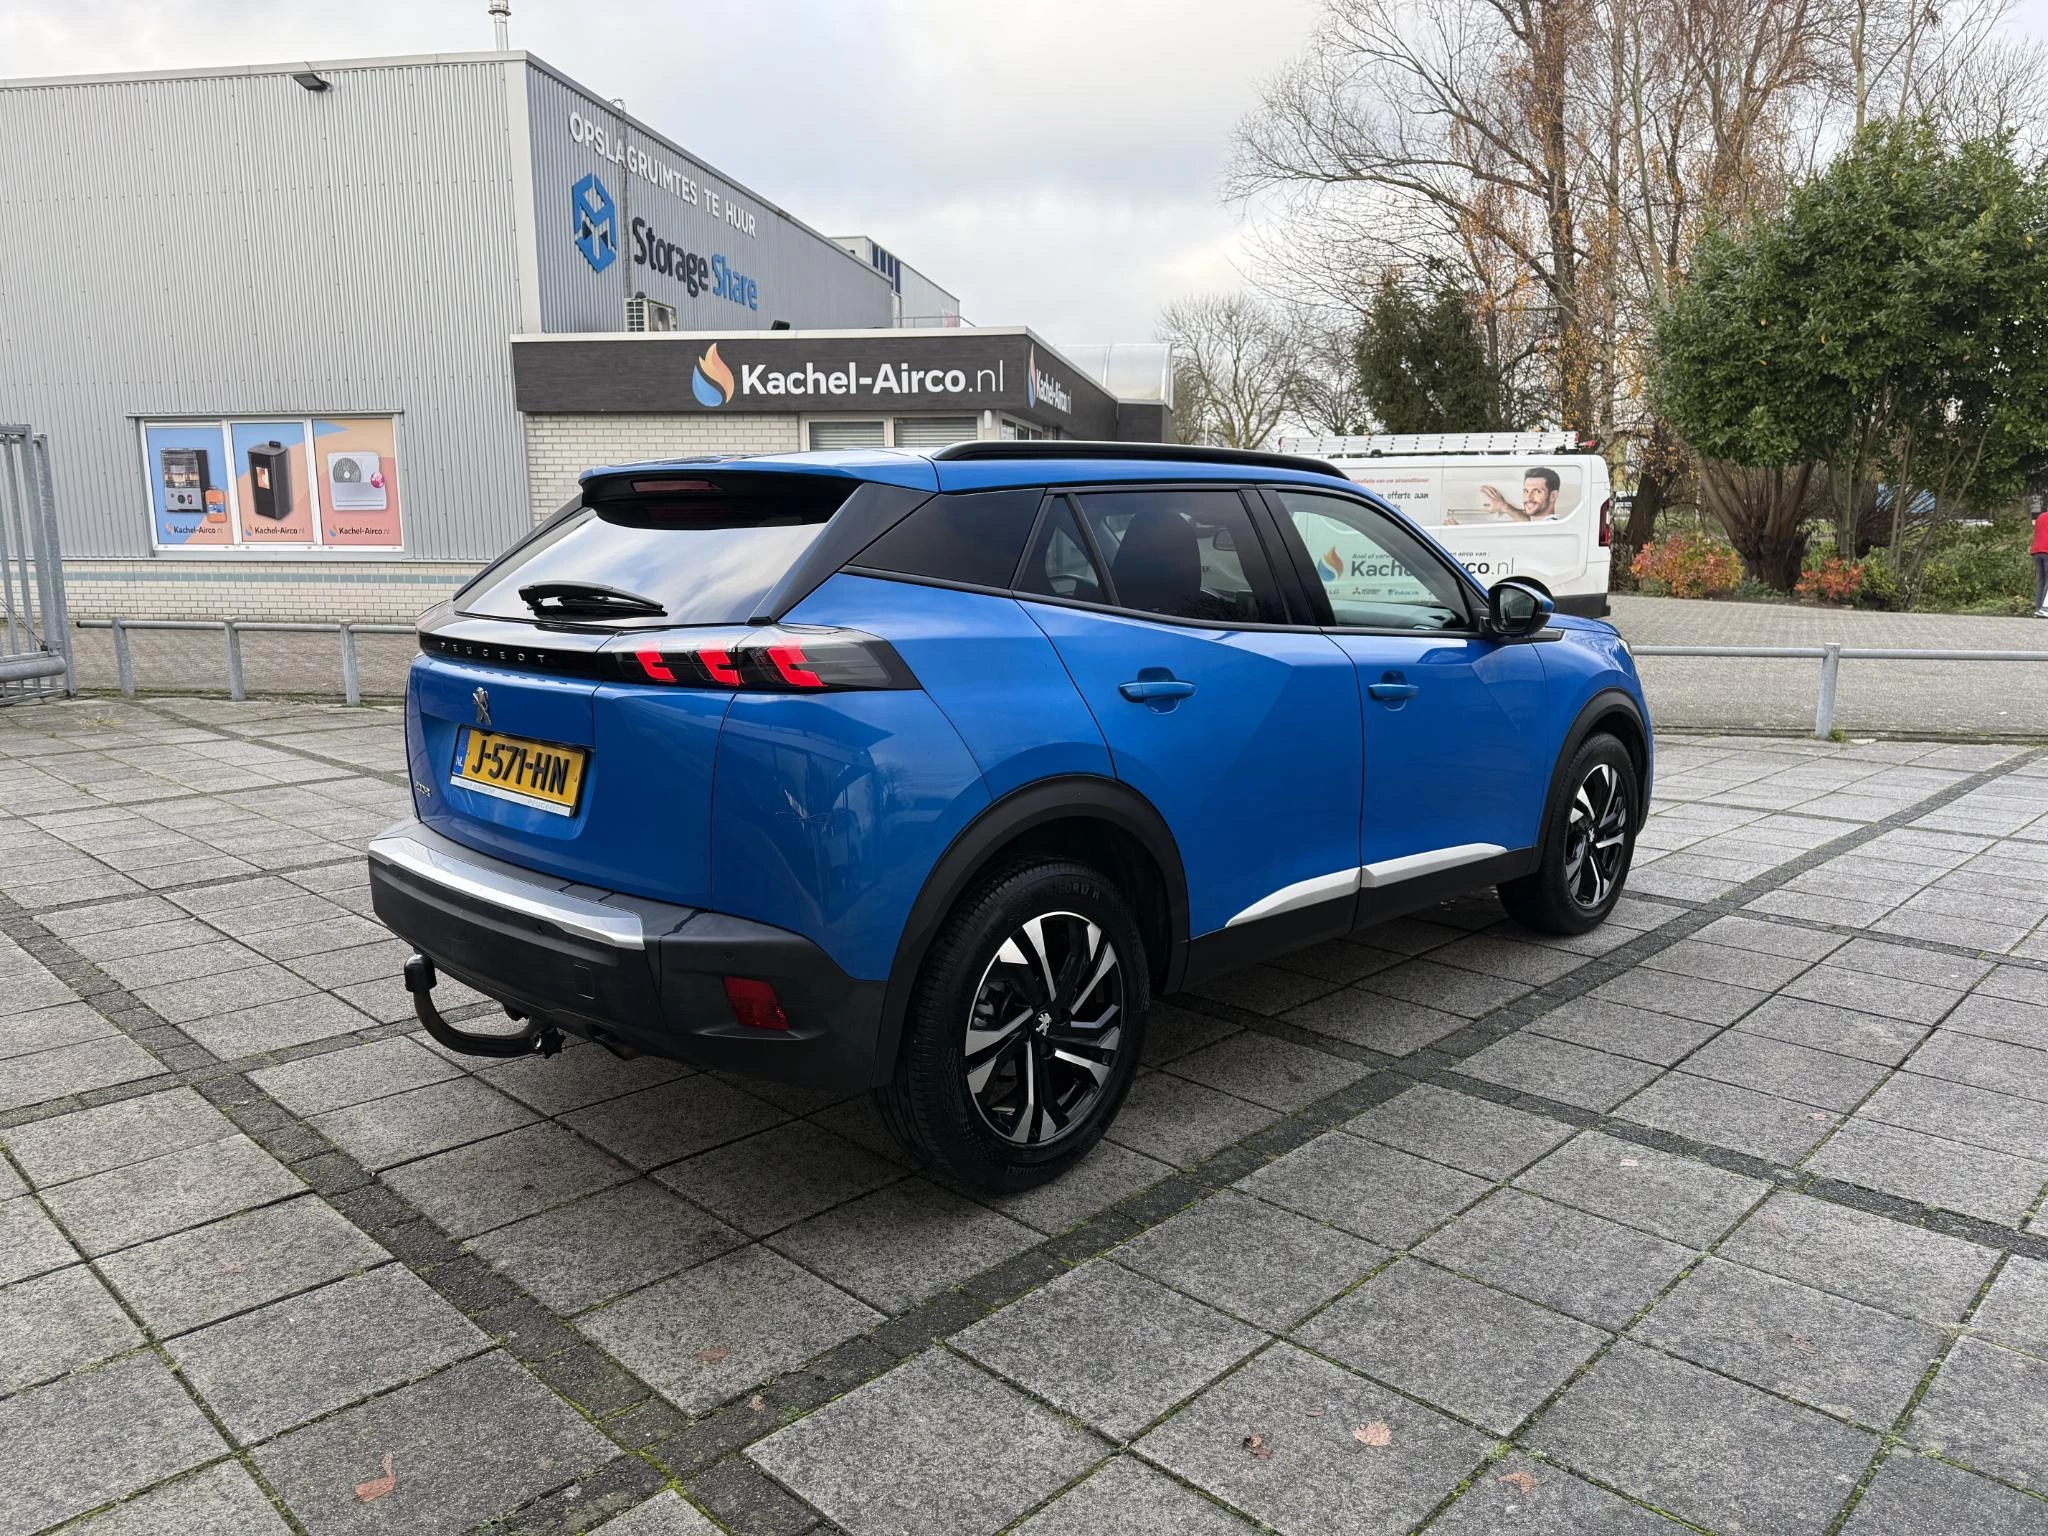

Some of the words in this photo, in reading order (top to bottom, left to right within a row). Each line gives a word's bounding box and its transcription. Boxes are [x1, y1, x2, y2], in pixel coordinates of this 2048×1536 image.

[569, 111, 698, 206] OPSLAGRUIMTES
[703, 188, 720, 219] TE
[725, 200, 756, 238] HUUR
[632, 216, 709, 298] Storage
[711, 253, 758, 311] Share
[741, 359, 1004, 395] Kachel-Airco.nl
[1036, 368, 1072, 415] Kachel-Airco.nl
[440, 641, 545, 664] PEUGEOT
[455, 755, 464, 768] NL
[471, 739, 570, 796] J-571-HN
